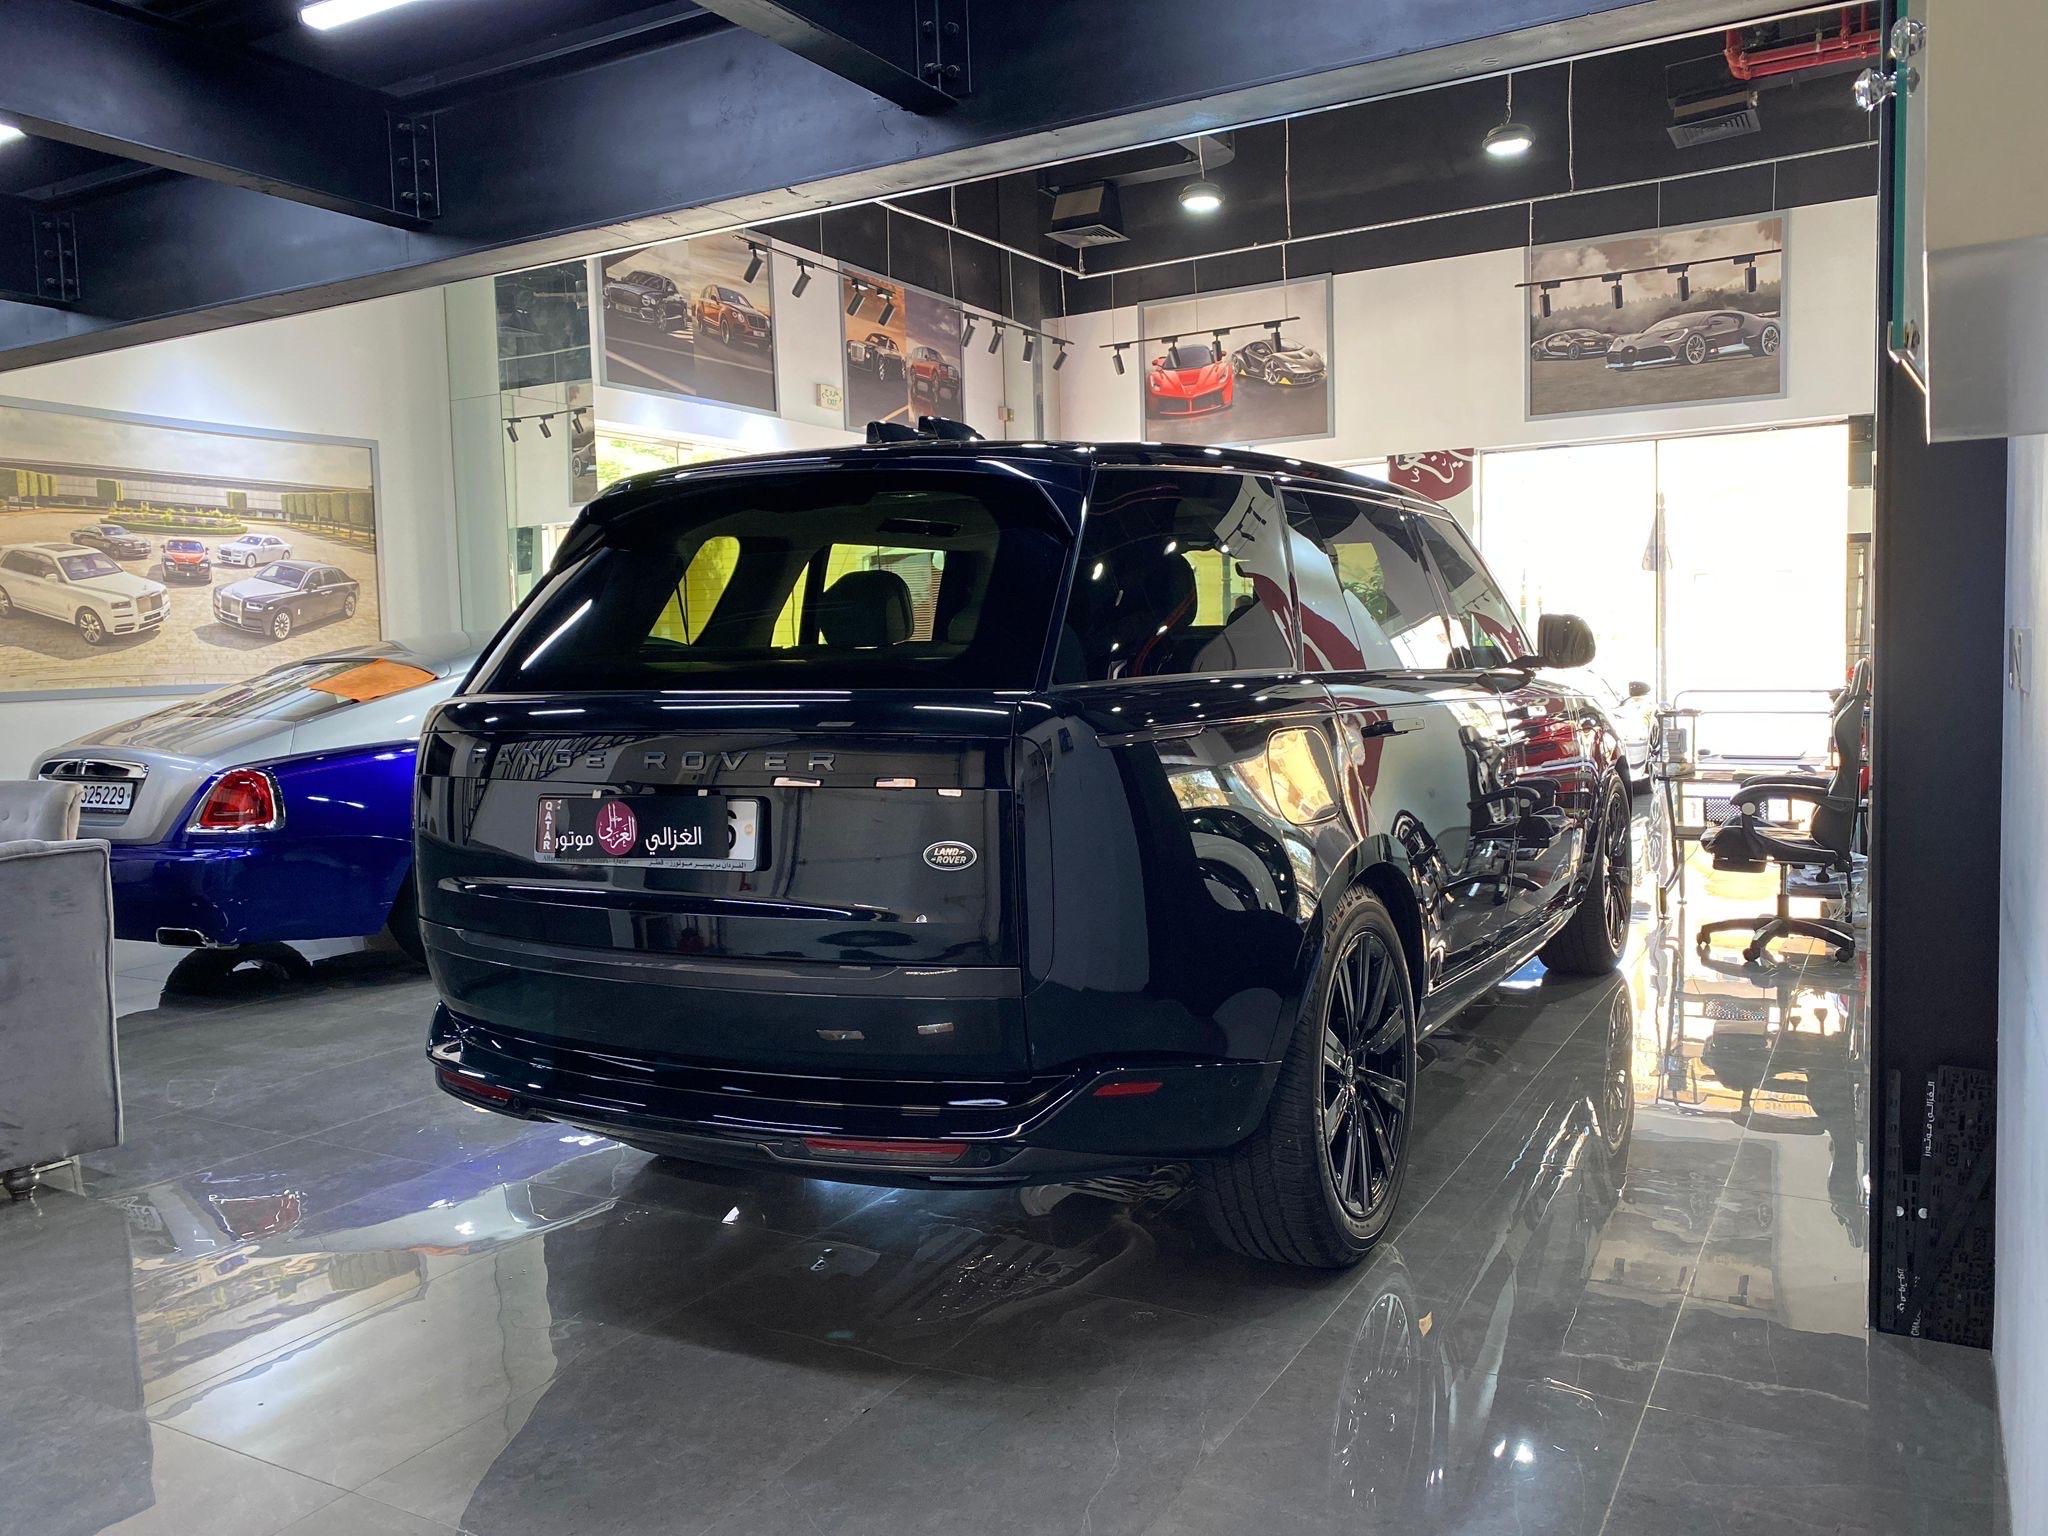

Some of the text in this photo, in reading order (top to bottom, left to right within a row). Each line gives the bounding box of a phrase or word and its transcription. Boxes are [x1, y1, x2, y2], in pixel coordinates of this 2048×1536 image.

[472, 748, 836, 771] RANGE ROVER
[543, 801, 553, 850] QATAR
[645, 826, 702, 855] الغزالي
